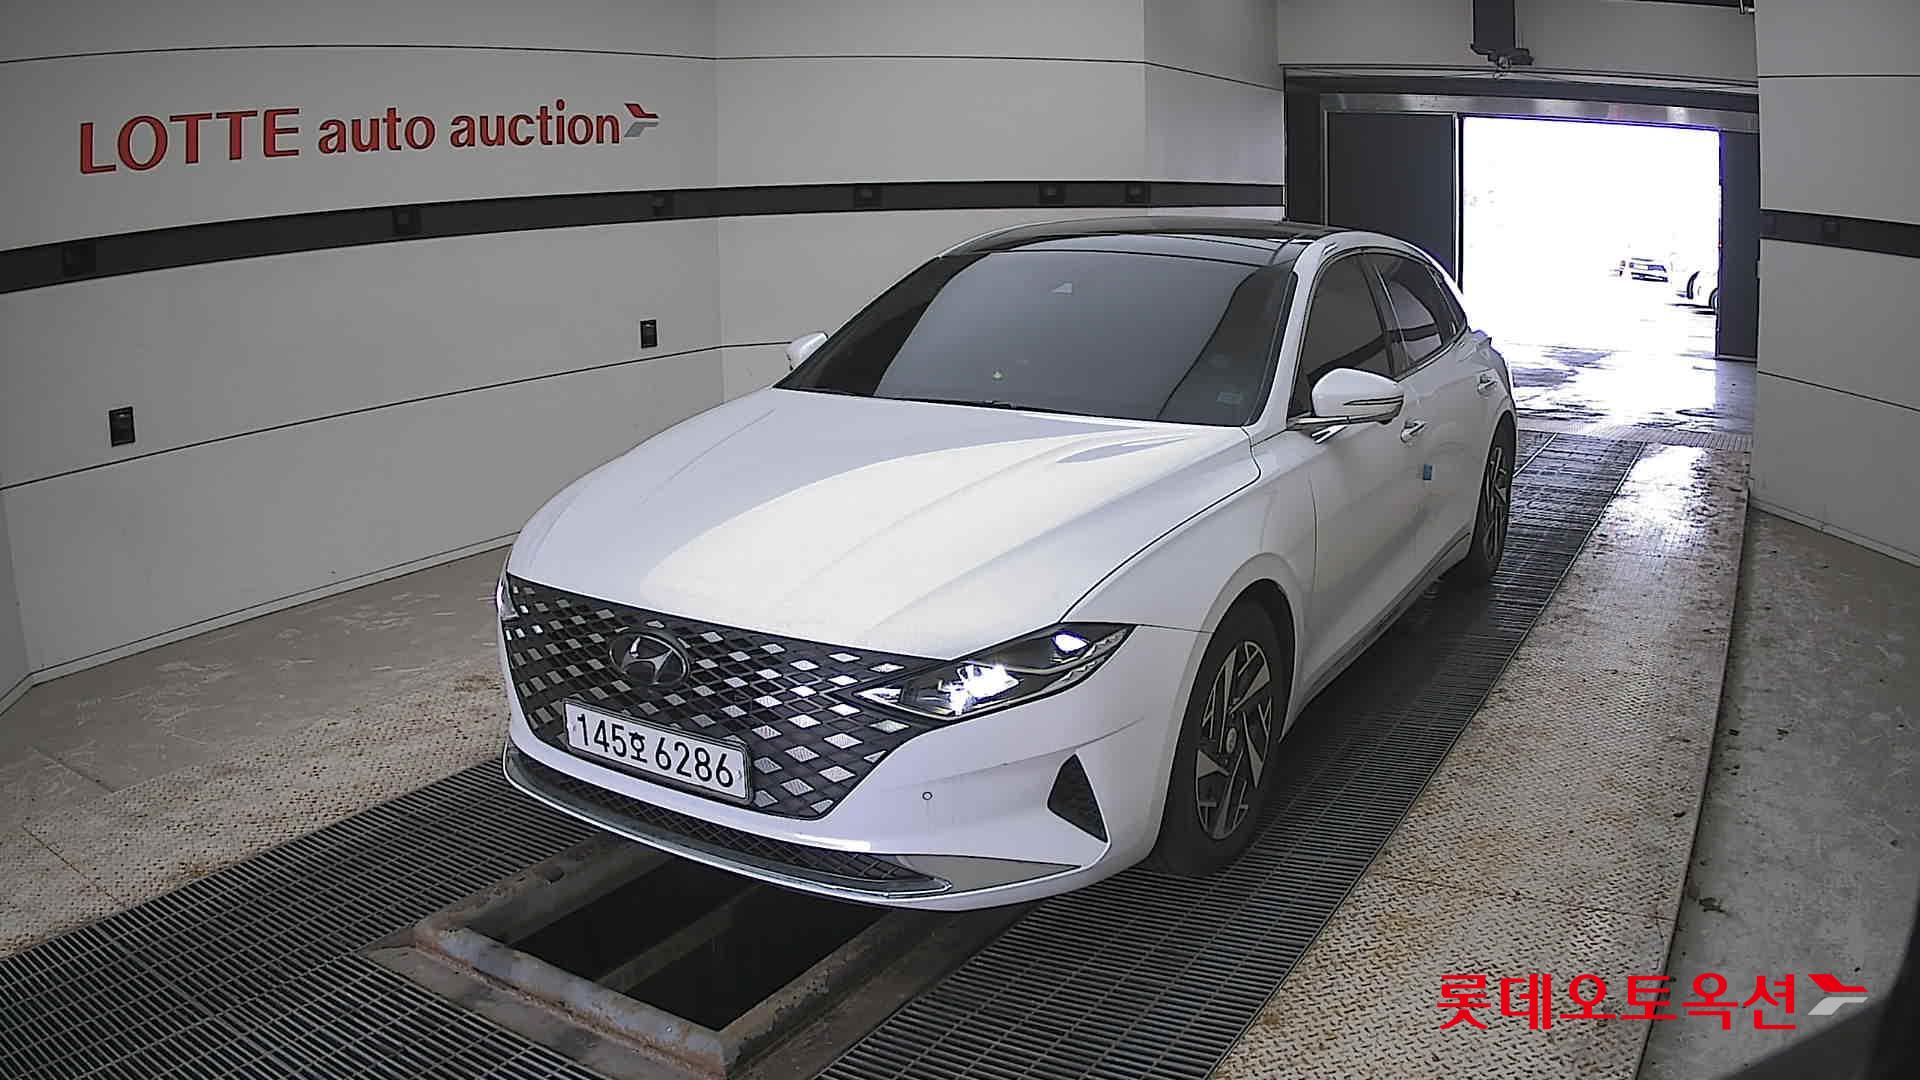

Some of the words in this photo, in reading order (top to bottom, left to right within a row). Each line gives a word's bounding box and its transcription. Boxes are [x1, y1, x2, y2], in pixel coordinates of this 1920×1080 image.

[79, 107, 301, 175] LOTTE
[317, 107, 436, 155] auto
[449, 98, 621, 148] auction
[576, 713, 648, 763] 145호
[655, 736, 734, 788] 6286
